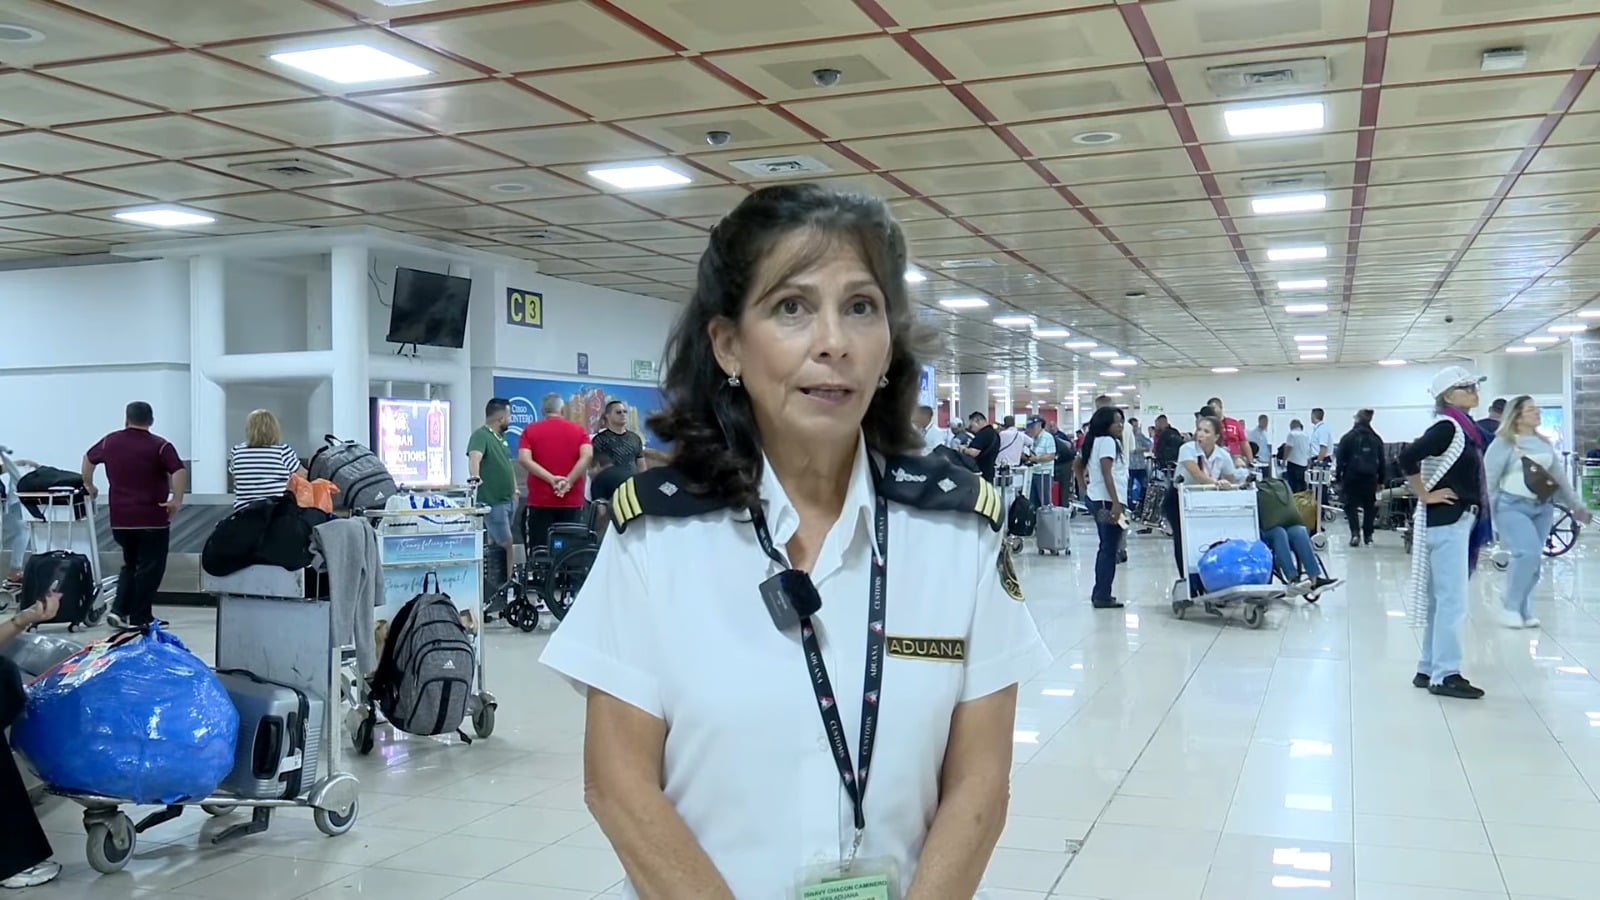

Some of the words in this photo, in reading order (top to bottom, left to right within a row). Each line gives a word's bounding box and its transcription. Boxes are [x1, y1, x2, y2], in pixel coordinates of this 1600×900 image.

[511, 292, 523, 323] C
[529, 300, 538, 320] 3
[509, 413, 534, 424] ONTERO
[874, 576, 882, 610] CUSTOMS
[870, 644, 879, 678] ADUANA
[890, 639, 963, 656] ADUANA
[810, 652, 823, 684] ADUANA
[829, 720, 845, 758] CUSTOMS
[863, 715, 872, 756] CUSTOMS
[827, 885, 854, 894] CHACON
